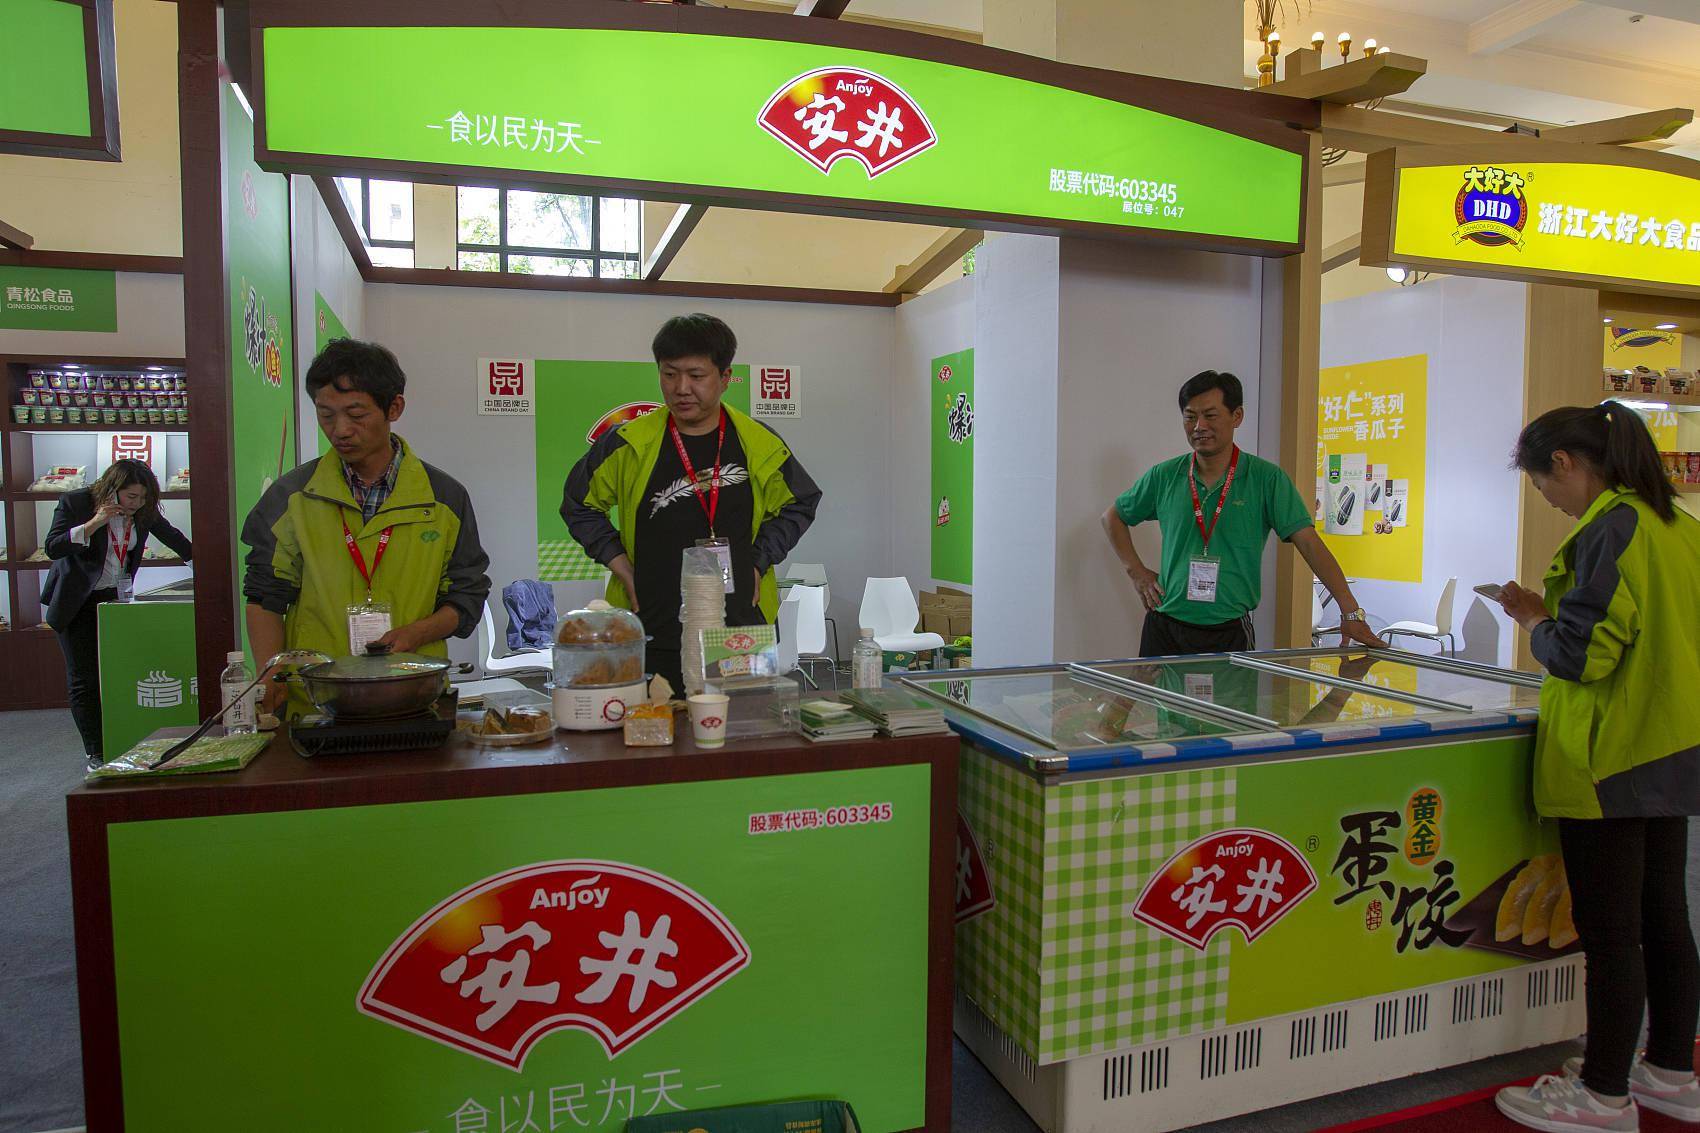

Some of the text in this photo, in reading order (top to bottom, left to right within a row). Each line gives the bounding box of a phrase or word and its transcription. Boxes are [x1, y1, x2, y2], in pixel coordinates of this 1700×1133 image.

[836, 78, 874, 97] Anjoy
[445, 110, 585, 155] 食以民为天
[793, 92, 904, 158] 安井
[1463, 166, 1525, 200] 大好大
[1473, 199, 1512, 220] DHD
[6, 286, 74, 304] 青松食品
[7, 303, 75, 312] QINGSONG FOODS
[484, 400, 530, 408] 中国品牌日
[756, 403, 796, 411] 中国品牌日
[1354, 418, 1405, 441] 香瓜子
[1410, 793, 1439, 859] 黄金
[1215, 836, 1255, 859] Anjoy
[529, 873, 611, 911] Anjoy
[1170, 856, 1285, 930] 安井
[439, 910, 680, 1032] 安井
[445, 1068, 689, 1133] 食以民为天
